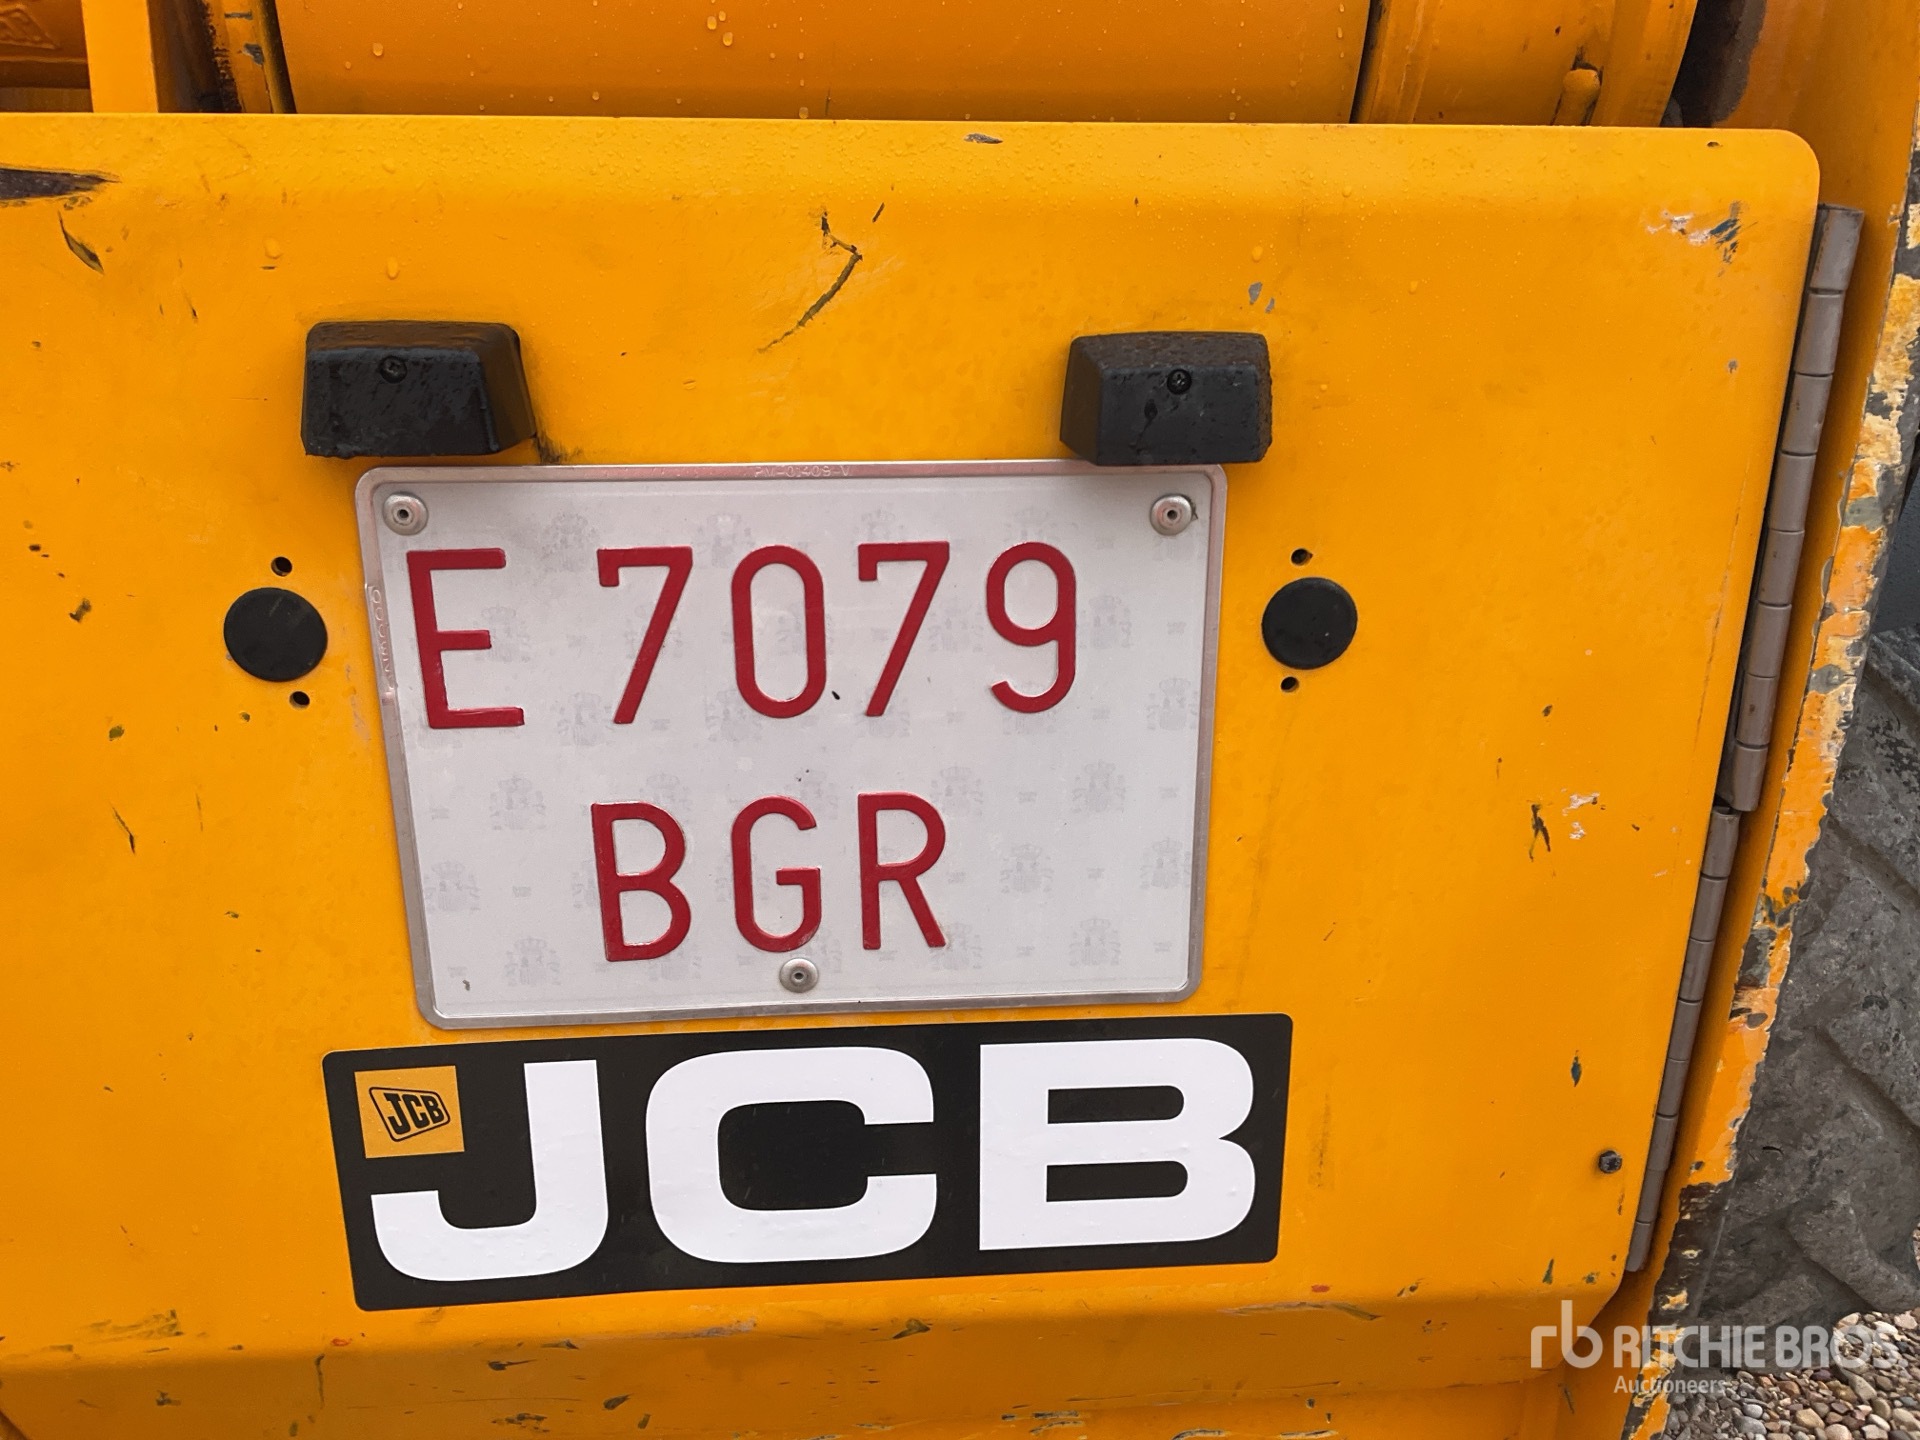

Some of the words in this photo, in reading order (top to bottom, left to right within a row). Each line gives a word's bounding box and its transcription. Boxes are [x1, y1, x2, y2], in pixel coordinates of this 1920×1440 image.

[407, 547, 525, 729] E
[597, 541, 1076, 725] 7079
[591, 792, 946, 962] BGR
[371, 1037, 1256, 1282] JCB
[383, 1092, 445, 1135] JCB
